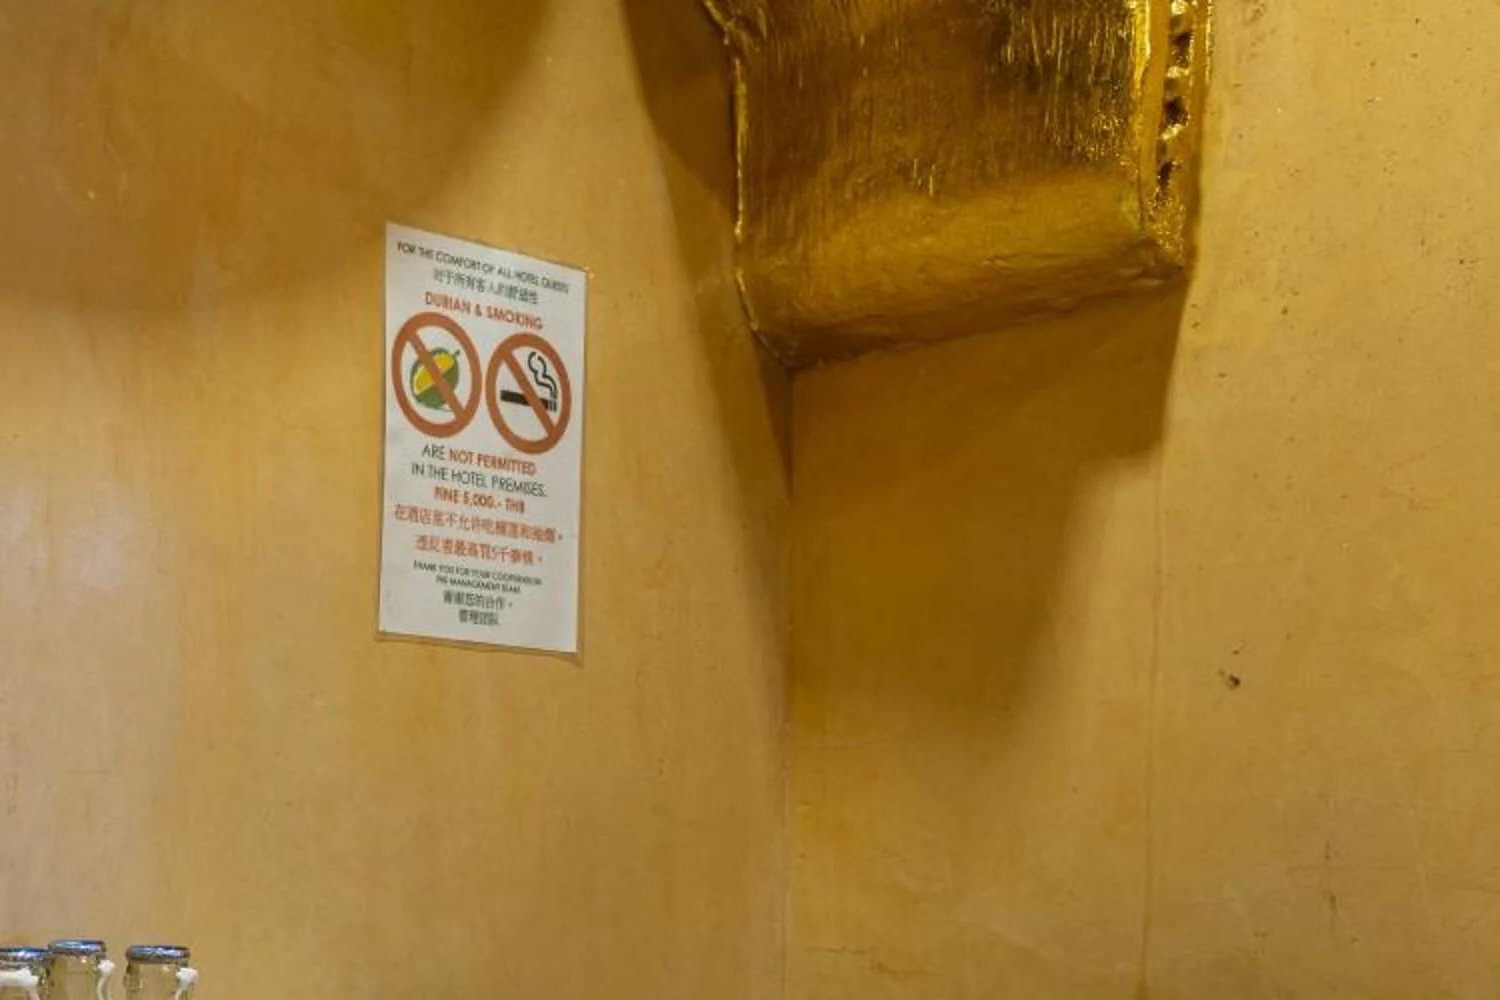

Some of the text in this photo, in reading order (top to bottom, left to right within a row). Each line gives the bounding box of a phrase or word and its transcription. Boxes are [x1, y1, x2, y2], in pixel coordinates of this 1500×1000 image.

[397, 241, 415, 254] FOR
[418, 246, 434, 260] THE
[435, 251, 481, 270] COMFORT
[482, 263, 494, 274] OF
[497, 265, 512, 279] ALL
[514, 269, 539, 287] HOTEL
[425, 291, 543, 330] DURIAN & SMOKING
[422, 443, 538, 477] ARE NOT PERMITTED
[411, 462, 548, 498] IN THE HOTEL PREMISES.
[434, 486, 460, 504] FINE
[505, 497, 526, 514] THB
